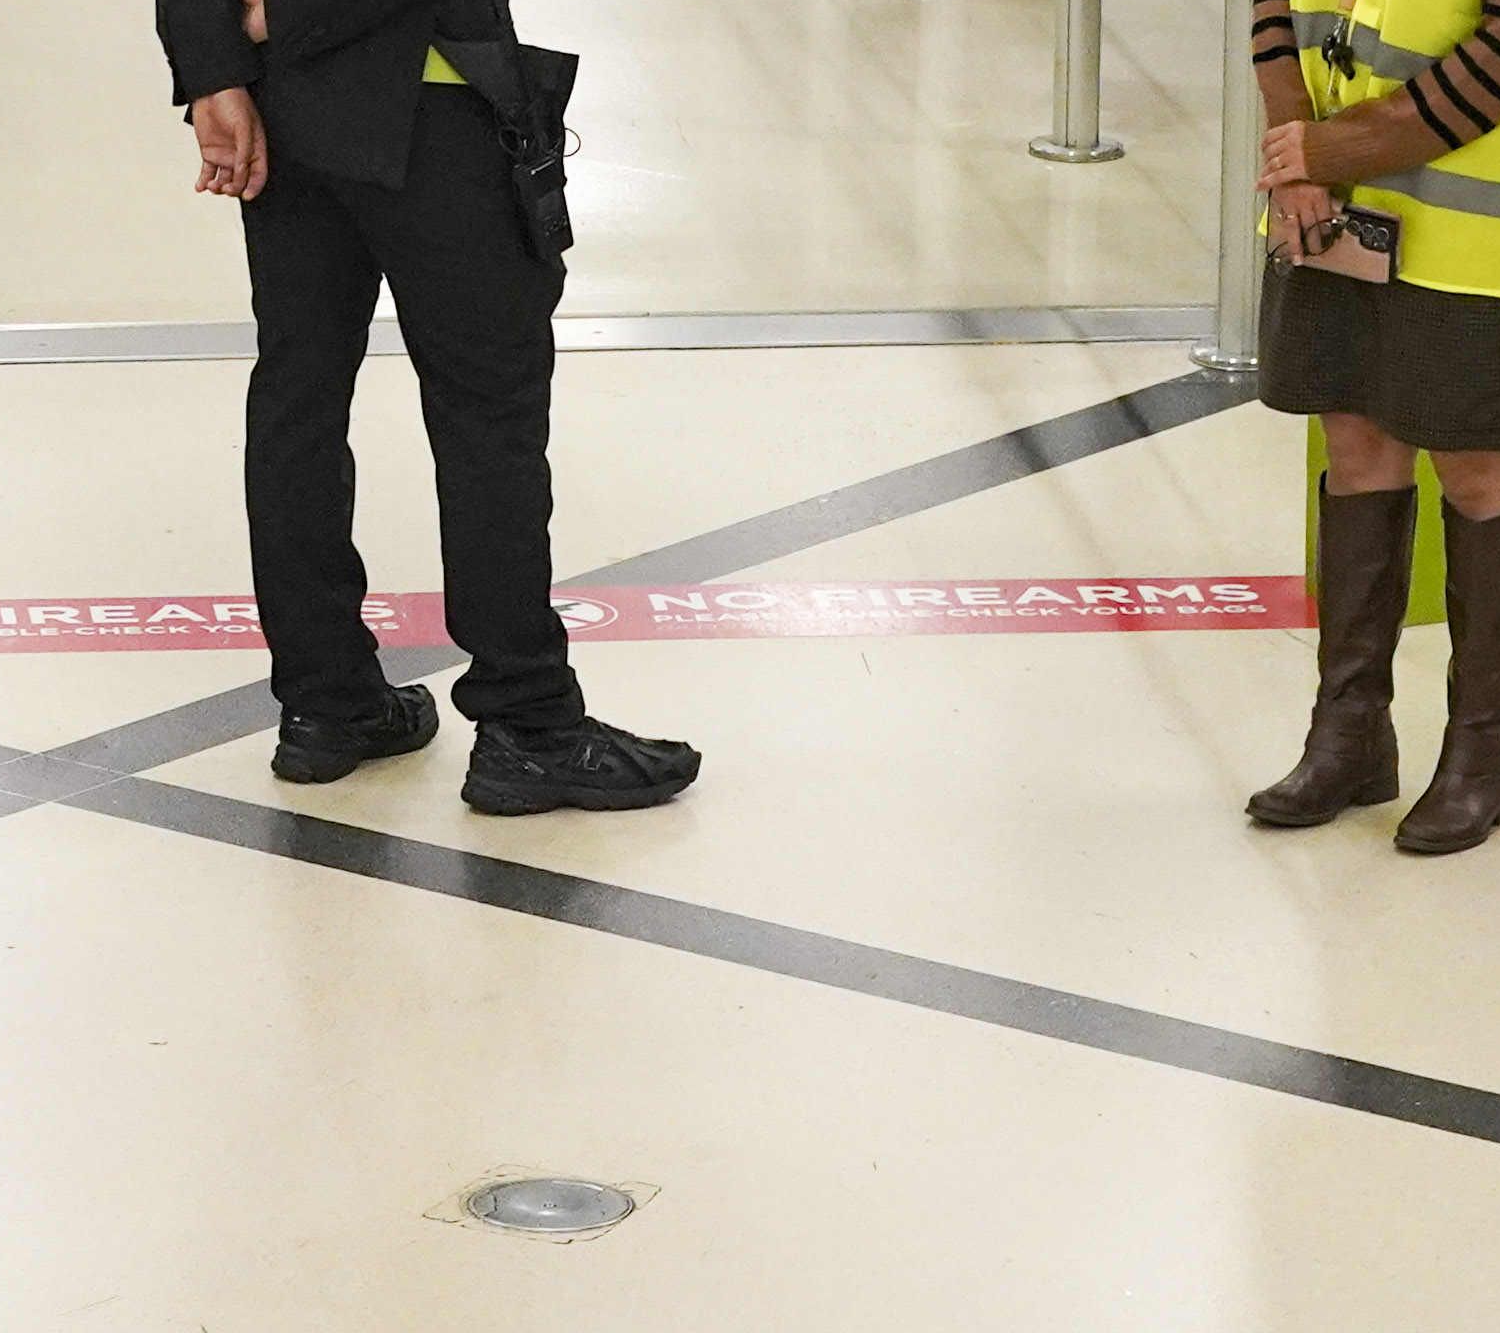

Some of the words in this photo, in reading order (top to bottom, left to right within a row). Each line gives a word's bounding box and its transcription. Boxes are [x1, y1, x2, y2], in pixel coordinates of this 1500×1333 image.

[647, 589, 778, 612] NO
[814, 582, 1261, 608] FIREARMS
[1071, 604, 1153, 617] YOUR
[1175, 602, 1269, 615] BAGS
[200, 623, 263, 634] YOU
